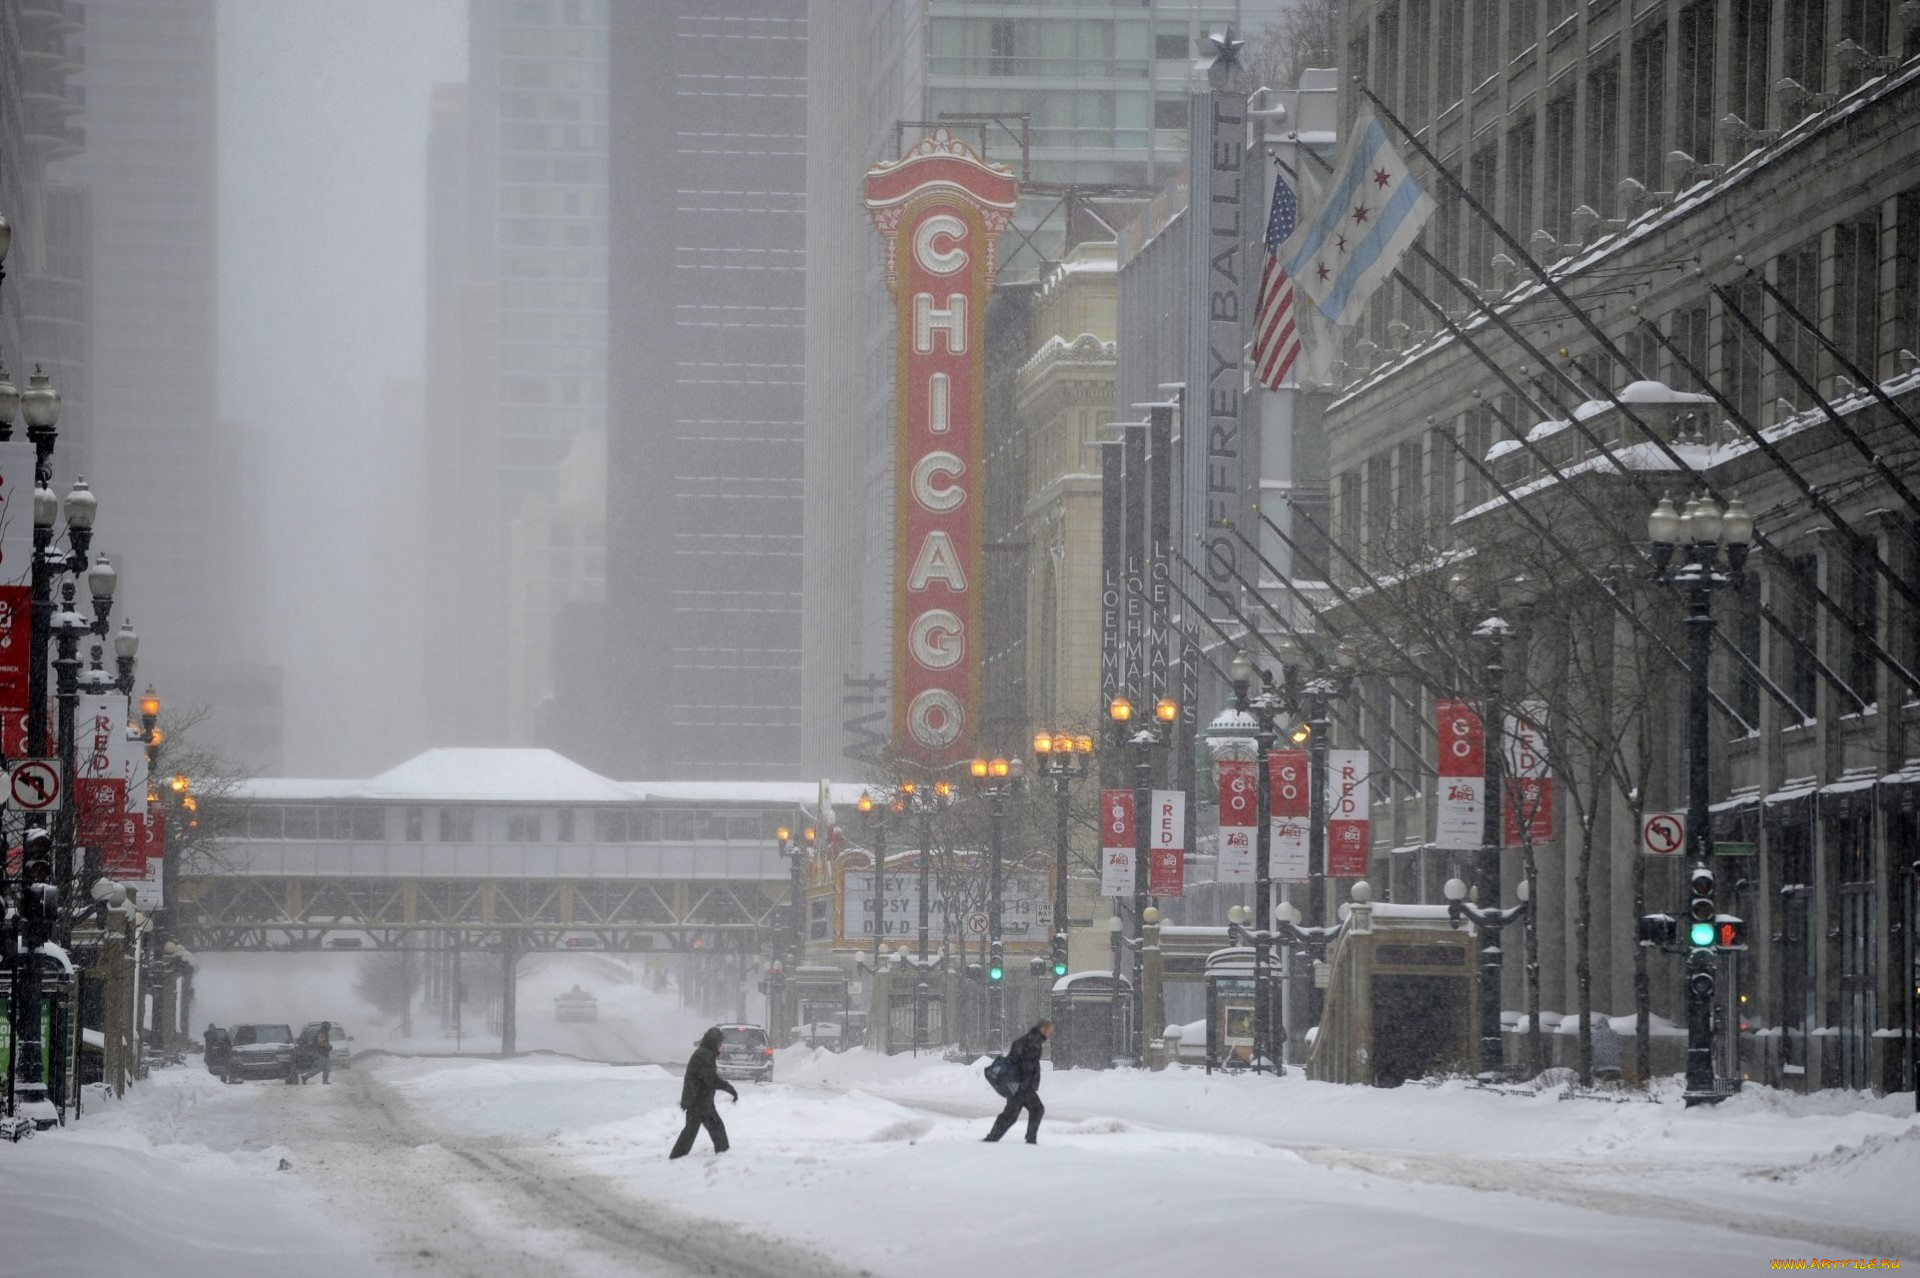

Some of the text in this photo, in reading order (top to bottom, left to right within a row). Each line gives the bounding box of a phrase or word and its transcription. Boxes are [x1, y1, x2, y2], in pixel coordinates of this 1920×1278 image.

[1210, 100, 1242, 323] BALLET
[907, 214, 969, 750] CHICAGO
[1207, 345, 1240, 616] JOFFREY
[92, 715, 110, 771] RED
[1452, 718, 1470, 757] GO
[1231, 778, 1246, 810] GO
[1281, 766, 1297, 800] GO
[1341, 766, 1356, 813] RED
[1161, 804, 1173, 844] RED
[864, 877, 905, 892] TEY
[863, 898, 909, 912] GPSY
